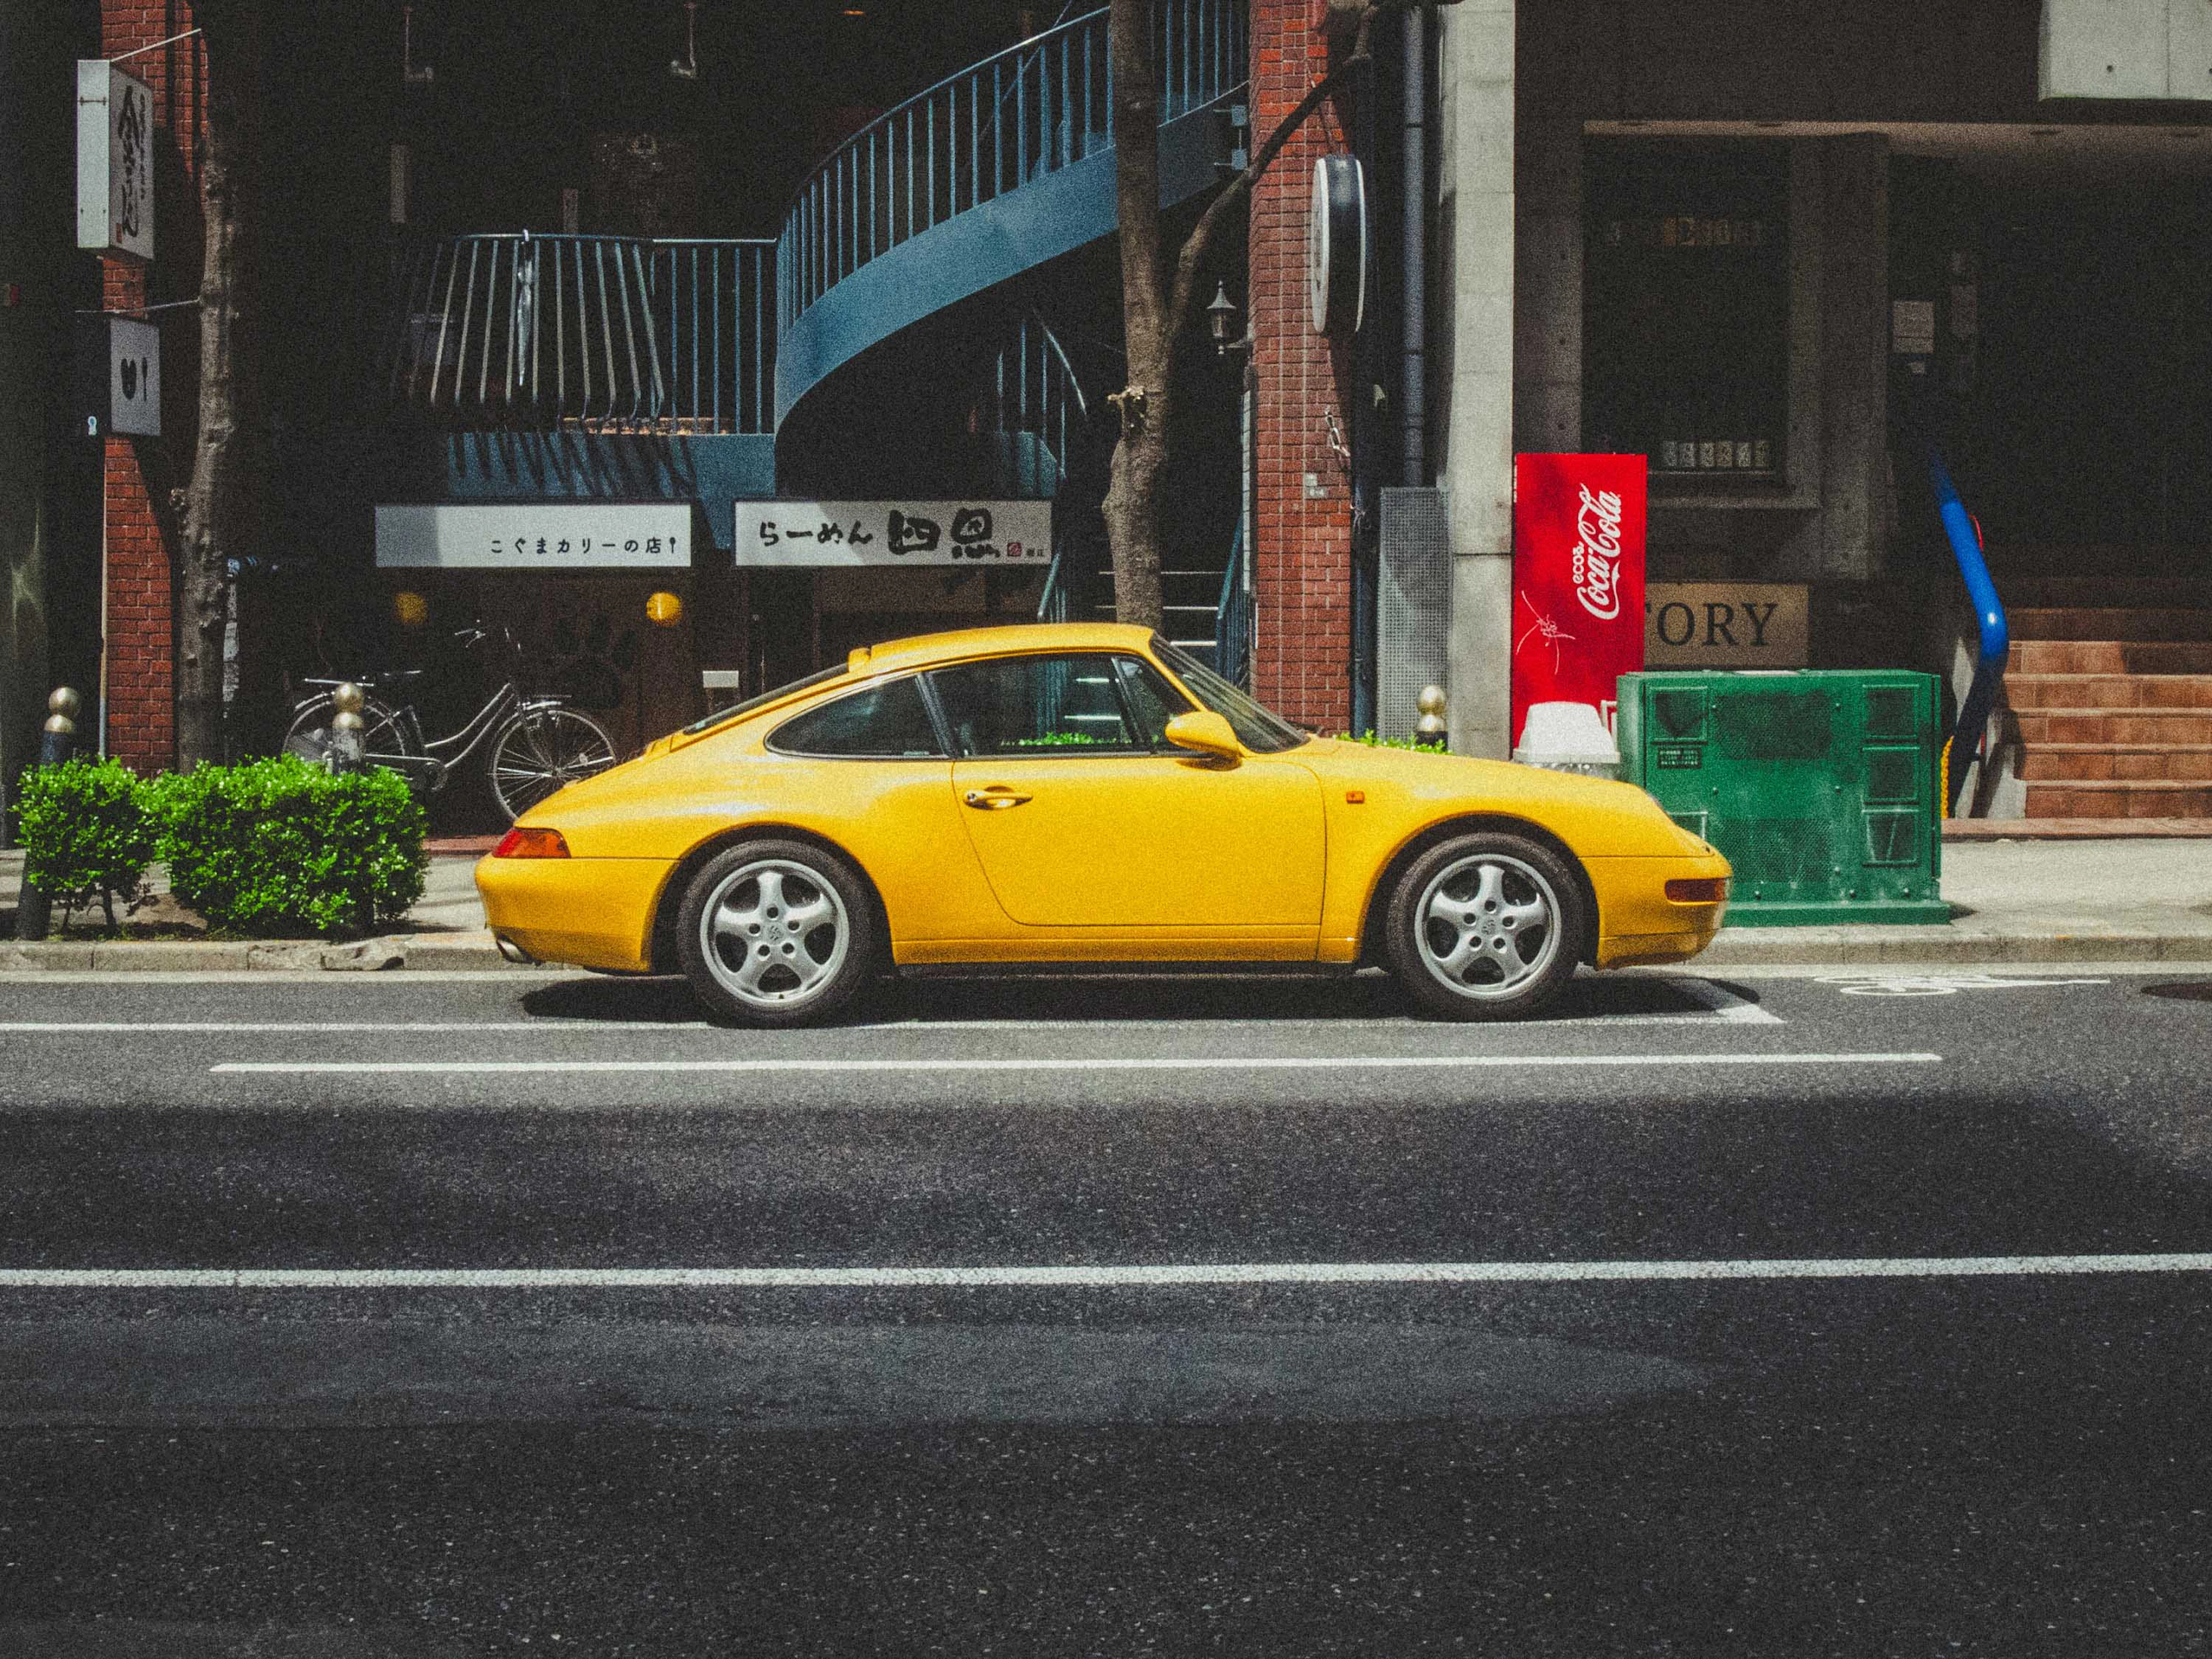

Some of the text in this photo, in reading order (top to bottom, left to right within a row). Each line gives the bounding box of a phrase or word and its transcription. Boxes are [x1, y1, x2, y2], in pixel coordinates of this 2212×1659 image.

[490, 537, 661, 554] こぐまカリーの店
[759, 520, 873, 547] らーめん
[1577, 483, 1622, 620] Coca-Cola
[1646, 602, 1778, 646] ORY
